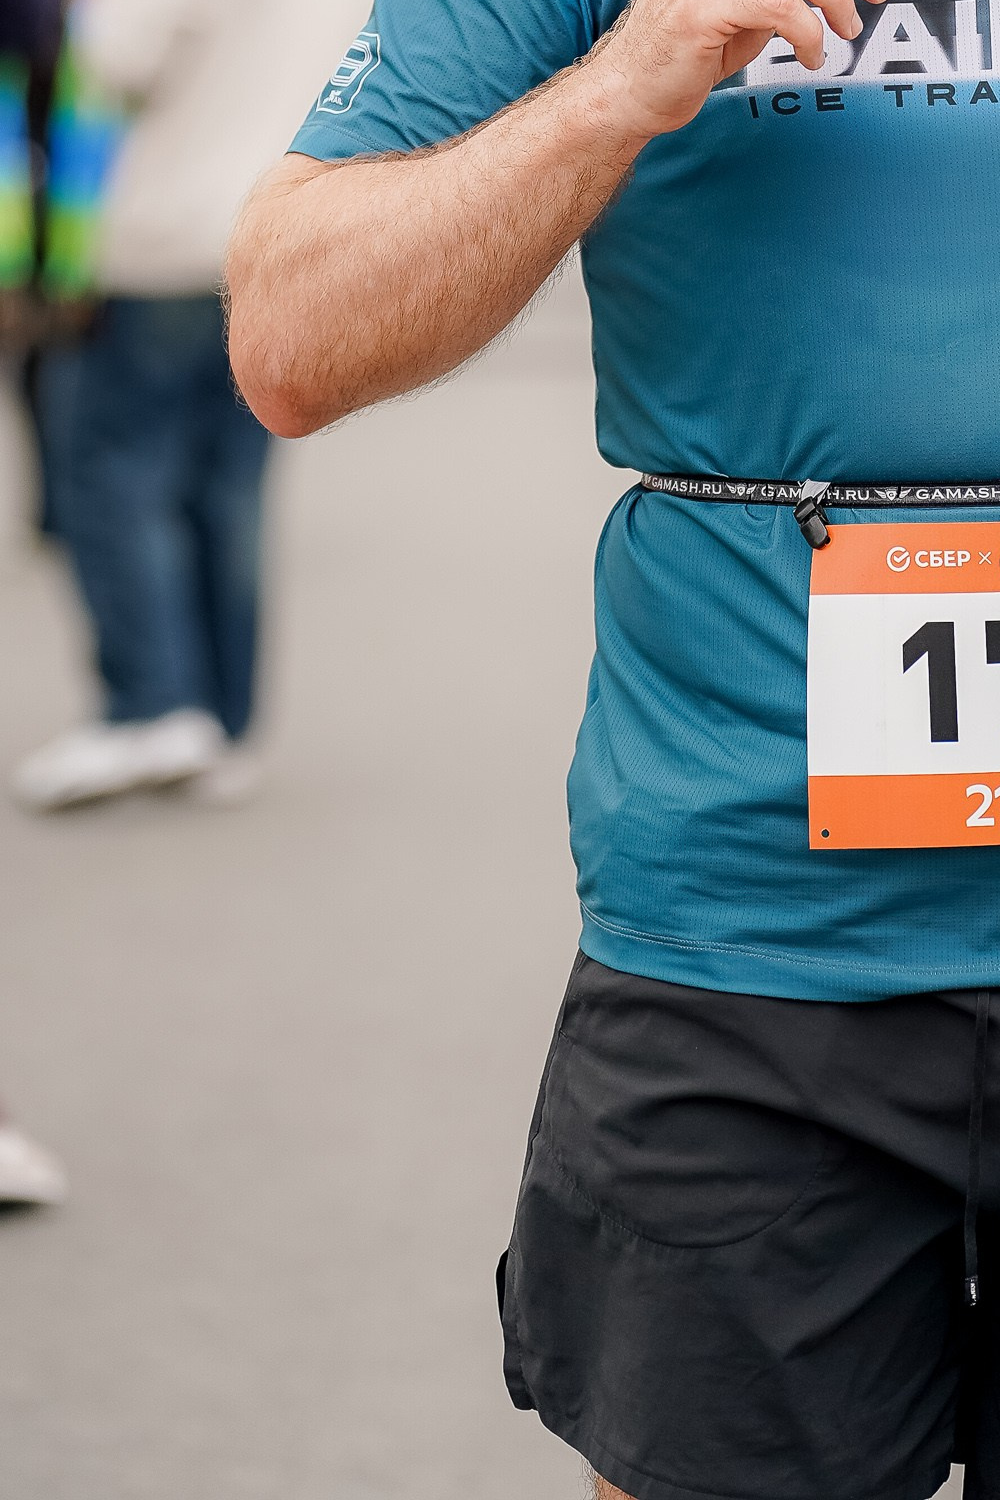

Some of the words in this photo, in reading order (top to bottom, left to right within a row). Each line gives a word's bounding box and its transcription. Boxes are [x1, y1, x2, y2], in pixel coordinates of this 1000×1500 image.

[749, 86, 845, 119] ICE
[651, 476, 722, 495] GAMASH.RU
[761, 483, 870, 501] GAMH.RU
[914, 550, 971, 568] СБЕР
